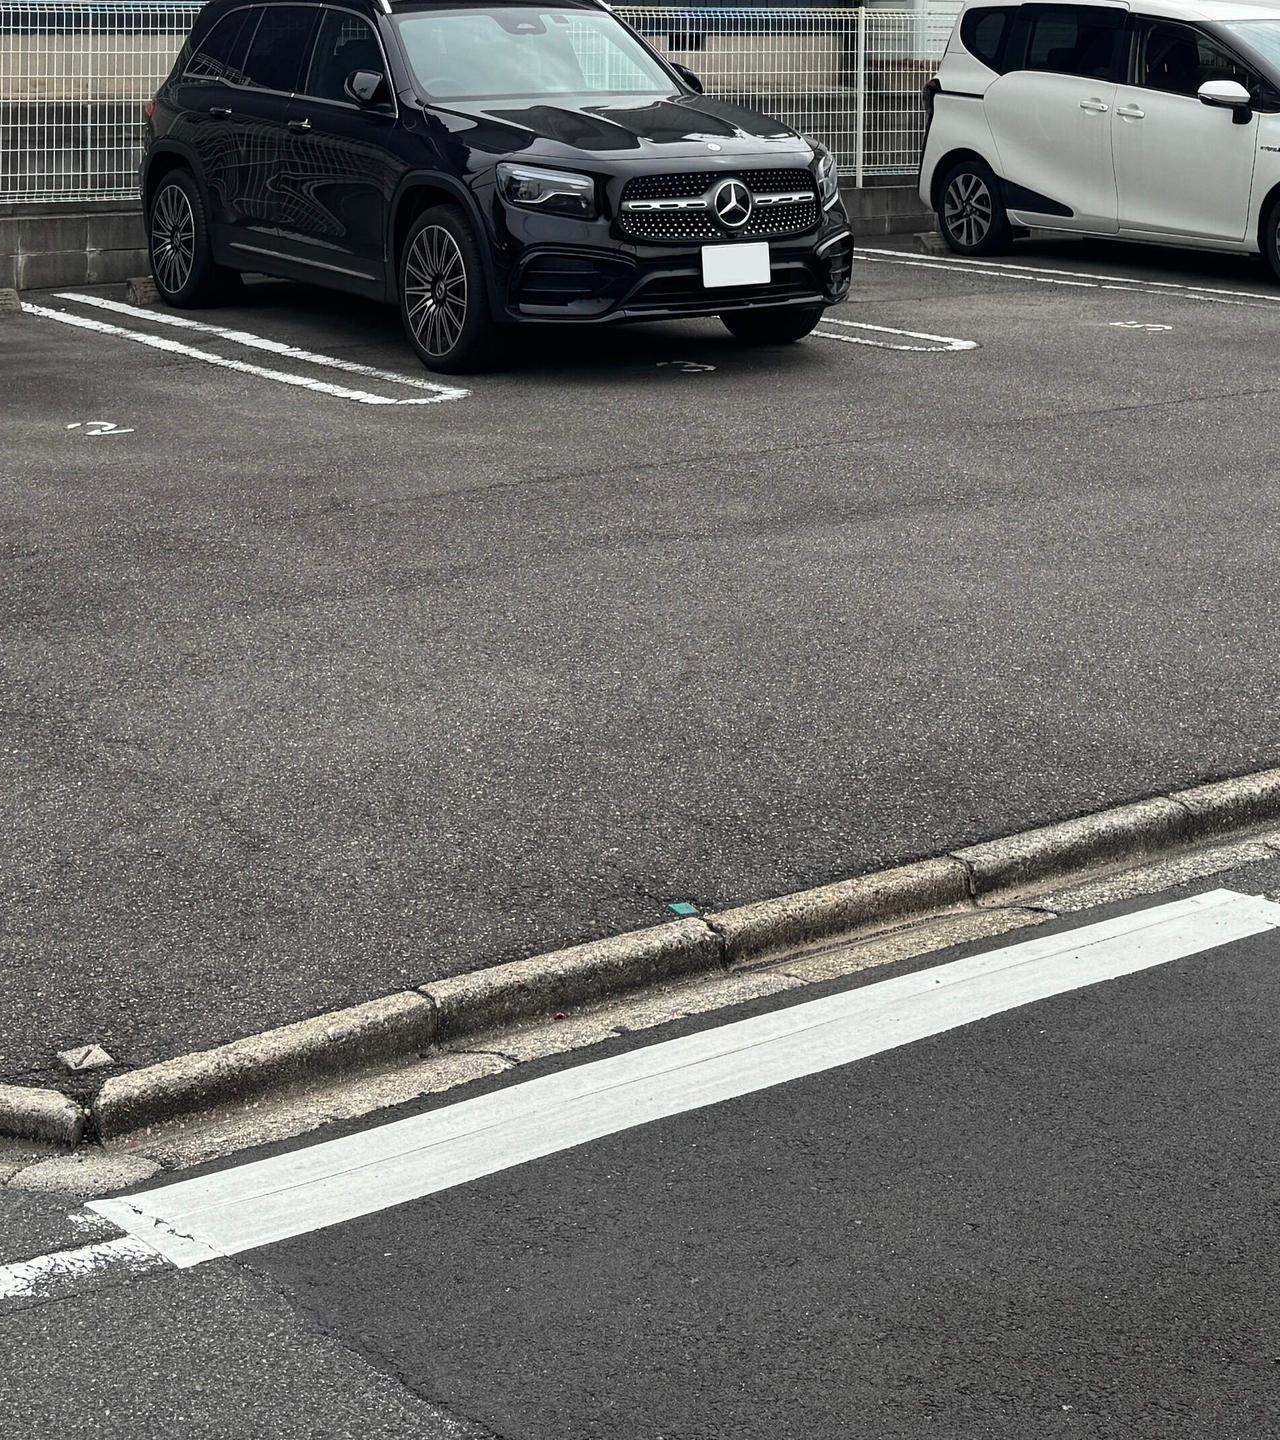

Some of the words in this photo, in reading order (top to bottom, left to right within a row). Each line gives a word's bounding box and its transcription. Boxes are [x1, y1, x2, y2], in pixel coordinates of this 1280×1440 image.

[1109, 320, 1173, 331] 5
[655, 360, 717, 372] 3
[66, 421, 135, 436] 2
